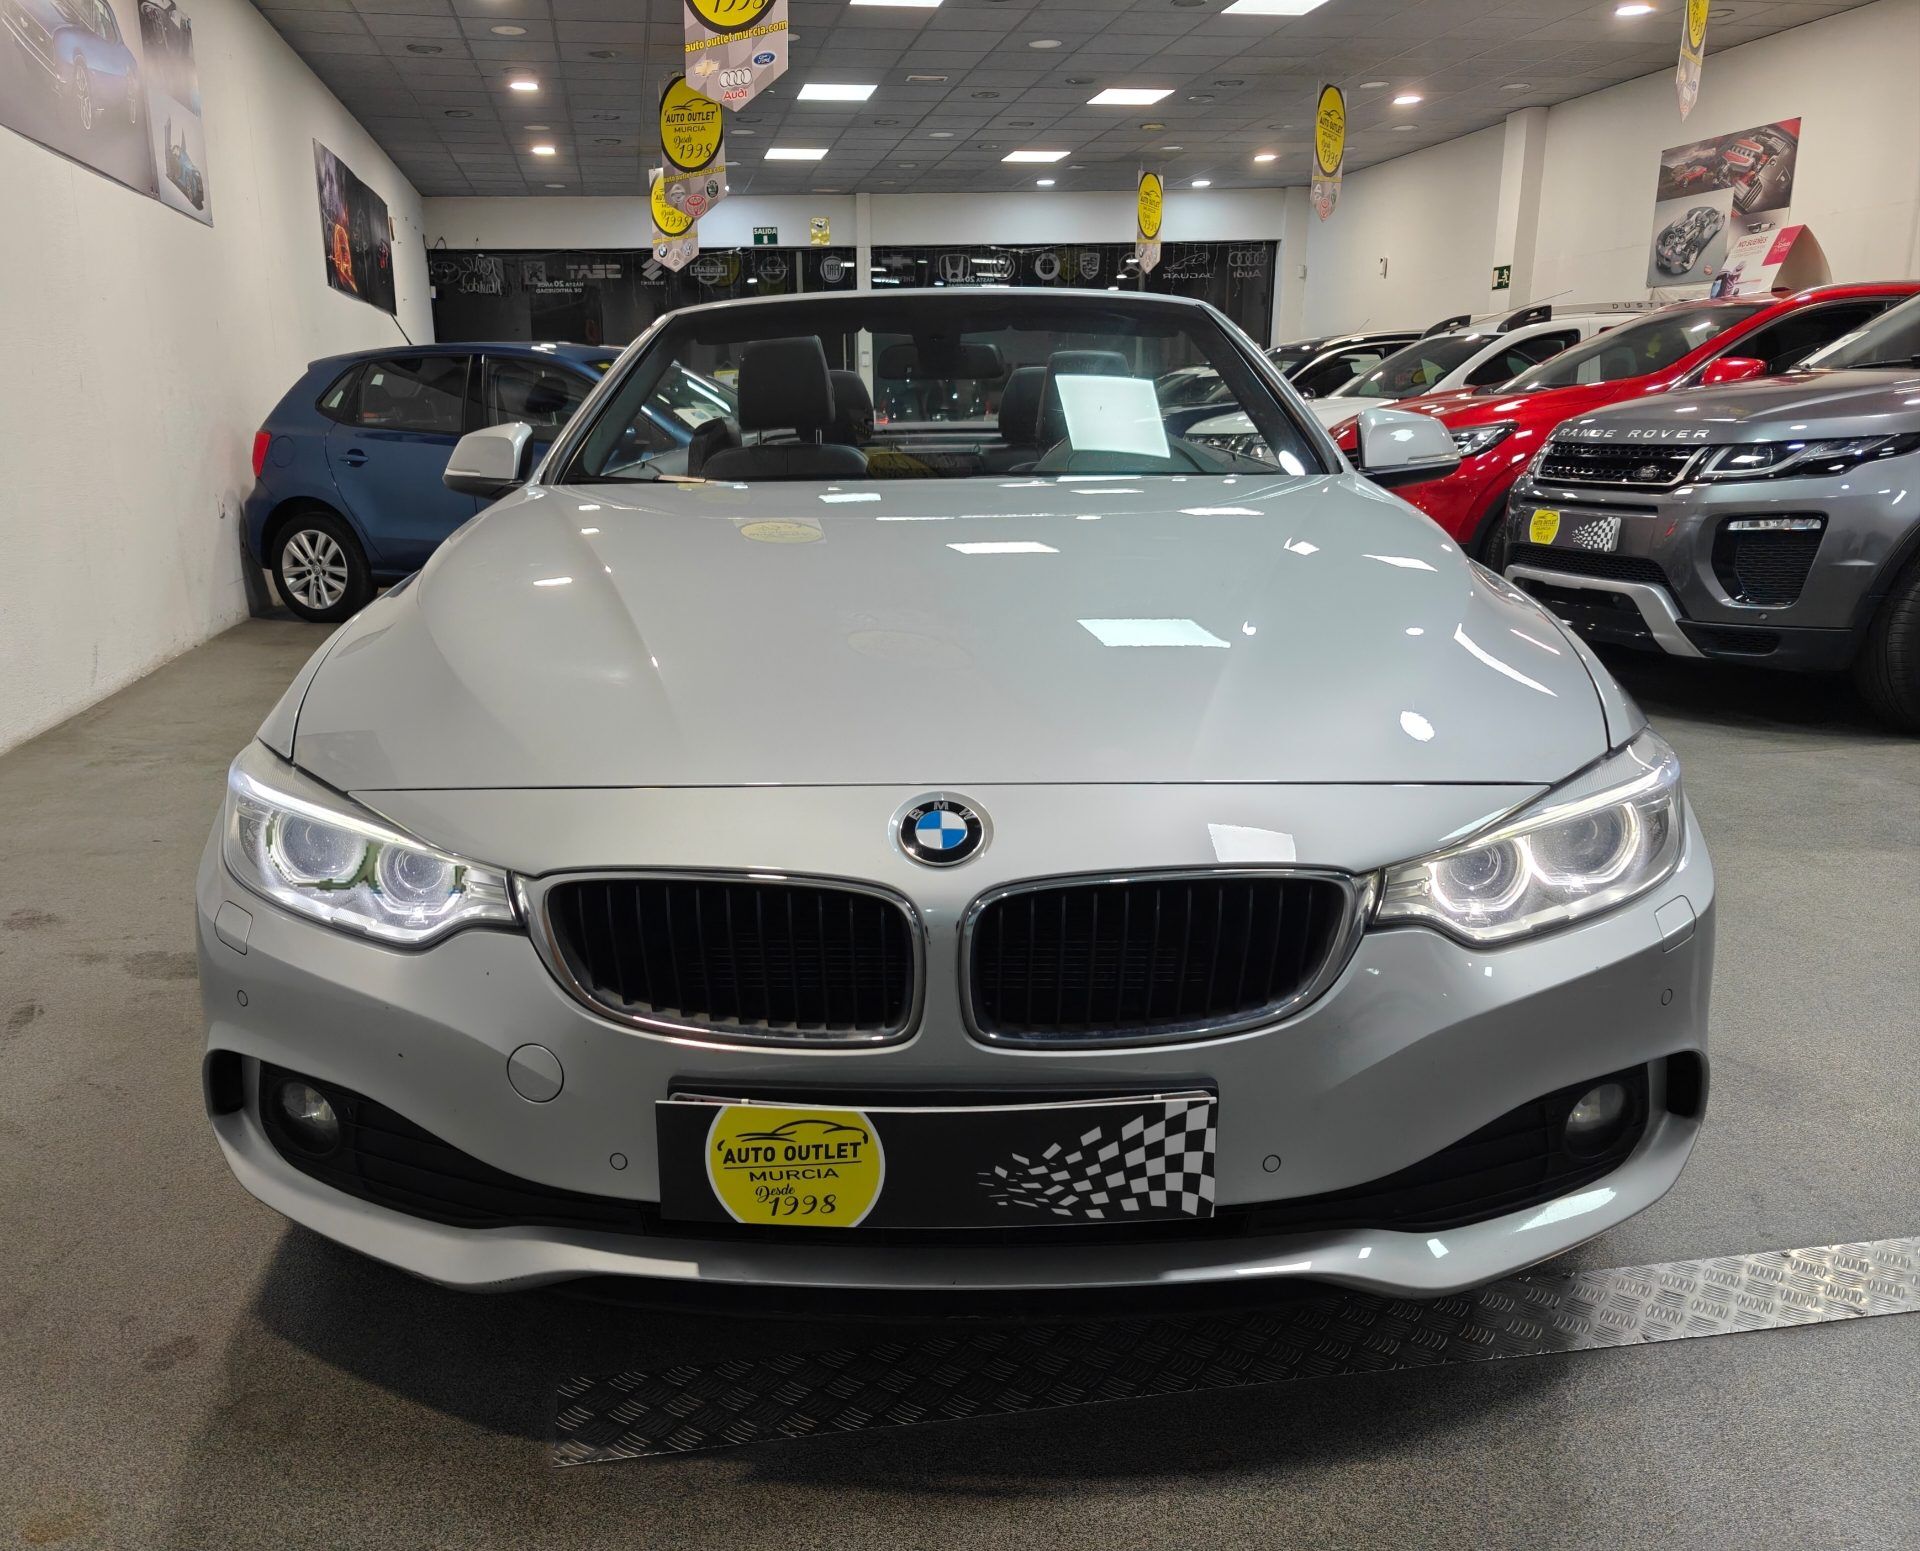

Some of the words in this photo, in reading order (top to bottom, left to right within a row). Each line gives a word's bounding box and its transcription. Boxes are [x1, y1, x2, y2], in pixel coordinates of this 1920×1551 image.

[685, 41, 705, 53] auto
[723, 89, 748, 100] Audi
[665, 113, 685, 123] AUTO
[687, 111, 716, 122] OUTLET
[679, 143, 712, 160] 1998
[664, 215, 689, 227] 1998
[1612, 302, 1675, 310] DUSTE
[1558, 428, 1617, 438] RANGE
[1627, 429, 1710, 439] ROVER
[907, 801, 977, 821] BMW
[723, 1146, 776, 1165] AUTO
[784, 1142, 862, 1161] OUTLET
[749, 1168, 839, 1182] MURCIA
[755, 1184, 795, 1203] Desde
[769, 1194, 837, 1217] 1998
